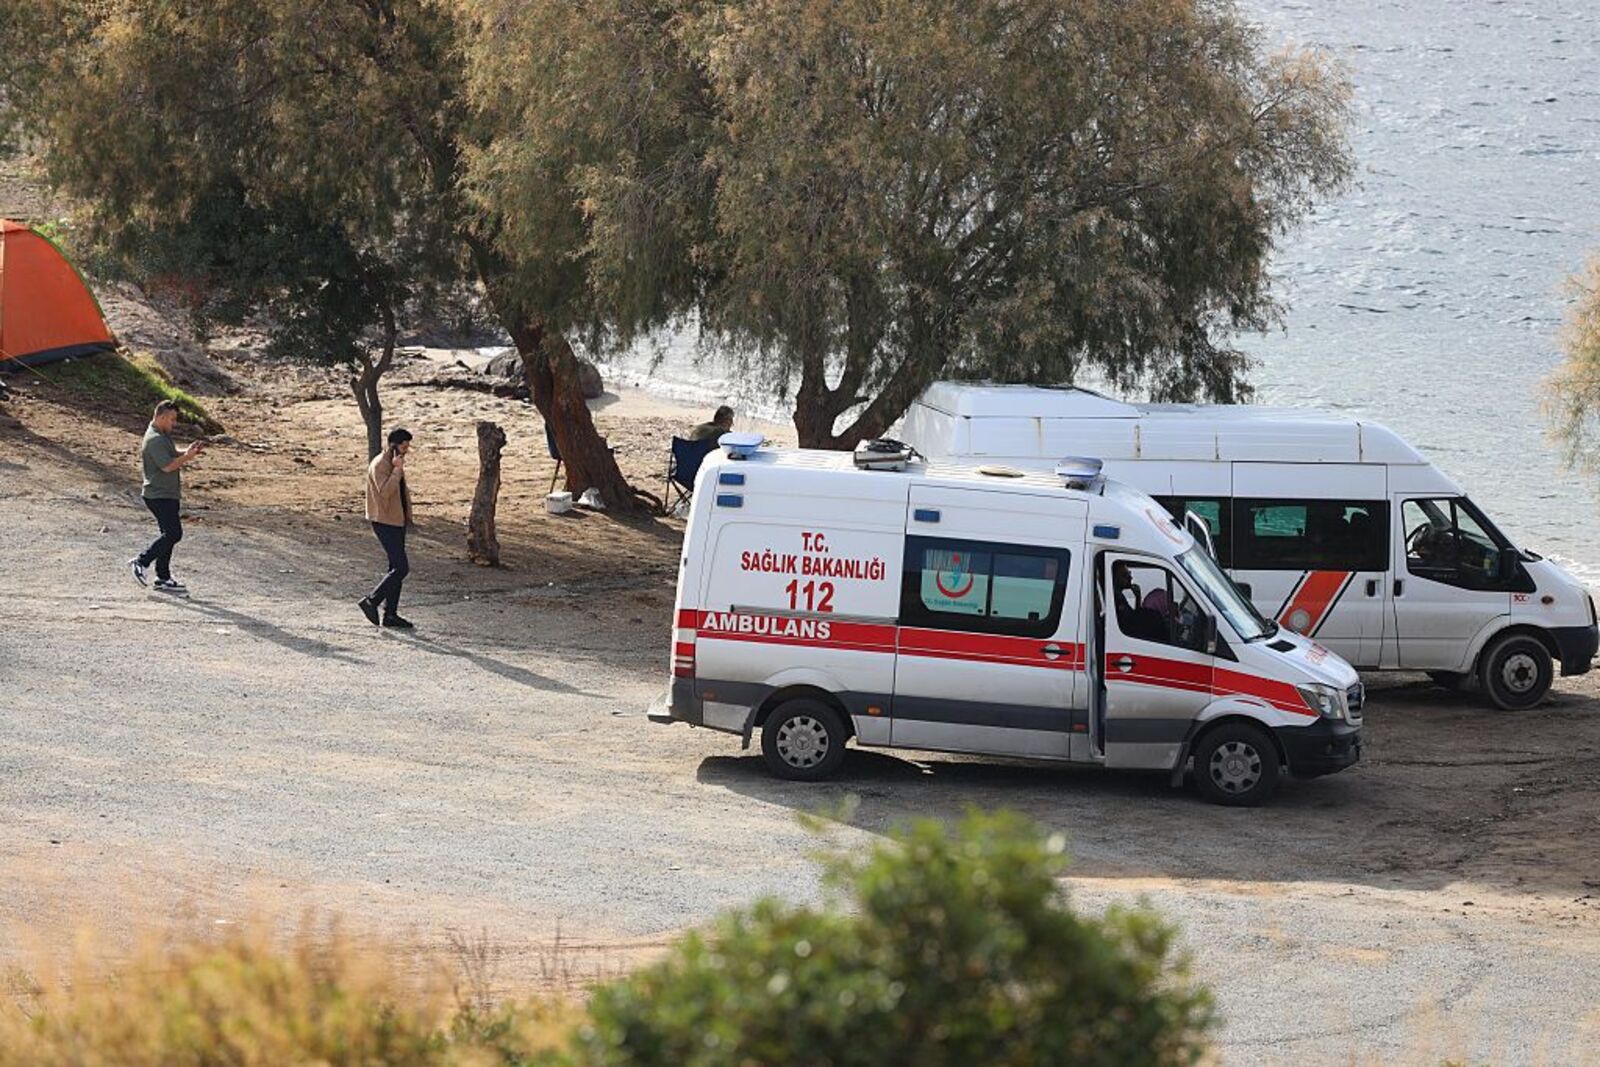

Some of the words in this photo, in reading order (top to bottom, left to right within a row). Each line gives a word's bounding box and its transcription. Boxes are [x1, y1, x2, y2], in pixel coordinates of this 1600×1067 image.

[801, 532, 829, 553] T.C.
[740, 548, 798, 574] SAĞLIK
[801, 555, 886, 581] BAKANLIĞI
[785, 579, 834, 613] 112
[702, 612, 831, 640] AMBULANS
